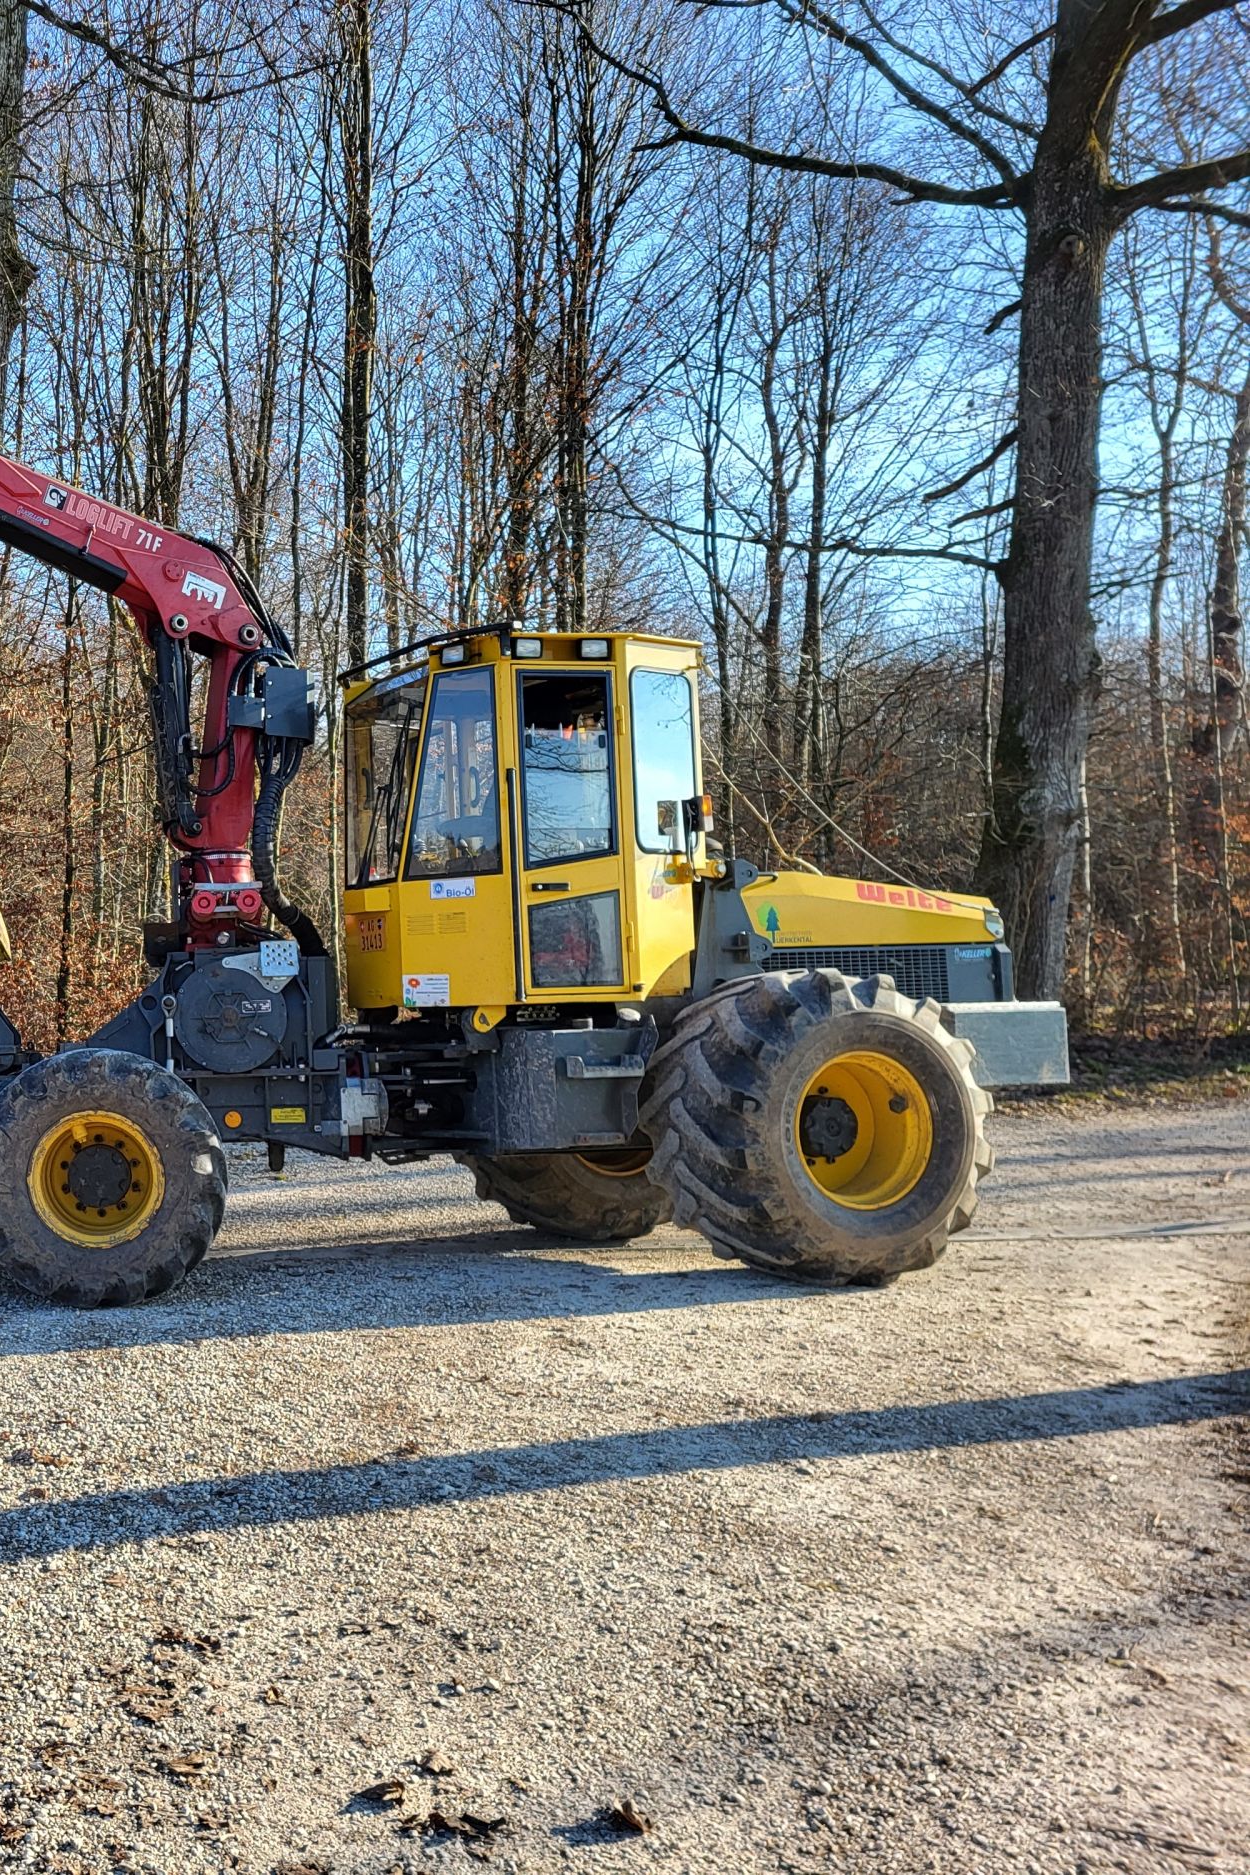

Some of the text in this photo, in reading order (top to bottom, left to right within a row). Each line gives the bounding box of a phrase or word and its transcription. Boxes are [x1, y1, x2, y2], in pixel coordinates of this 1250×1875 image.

[66, 494, 163, 553] LOGLIFT 71F
[856, 882, 952, 912] Welte
